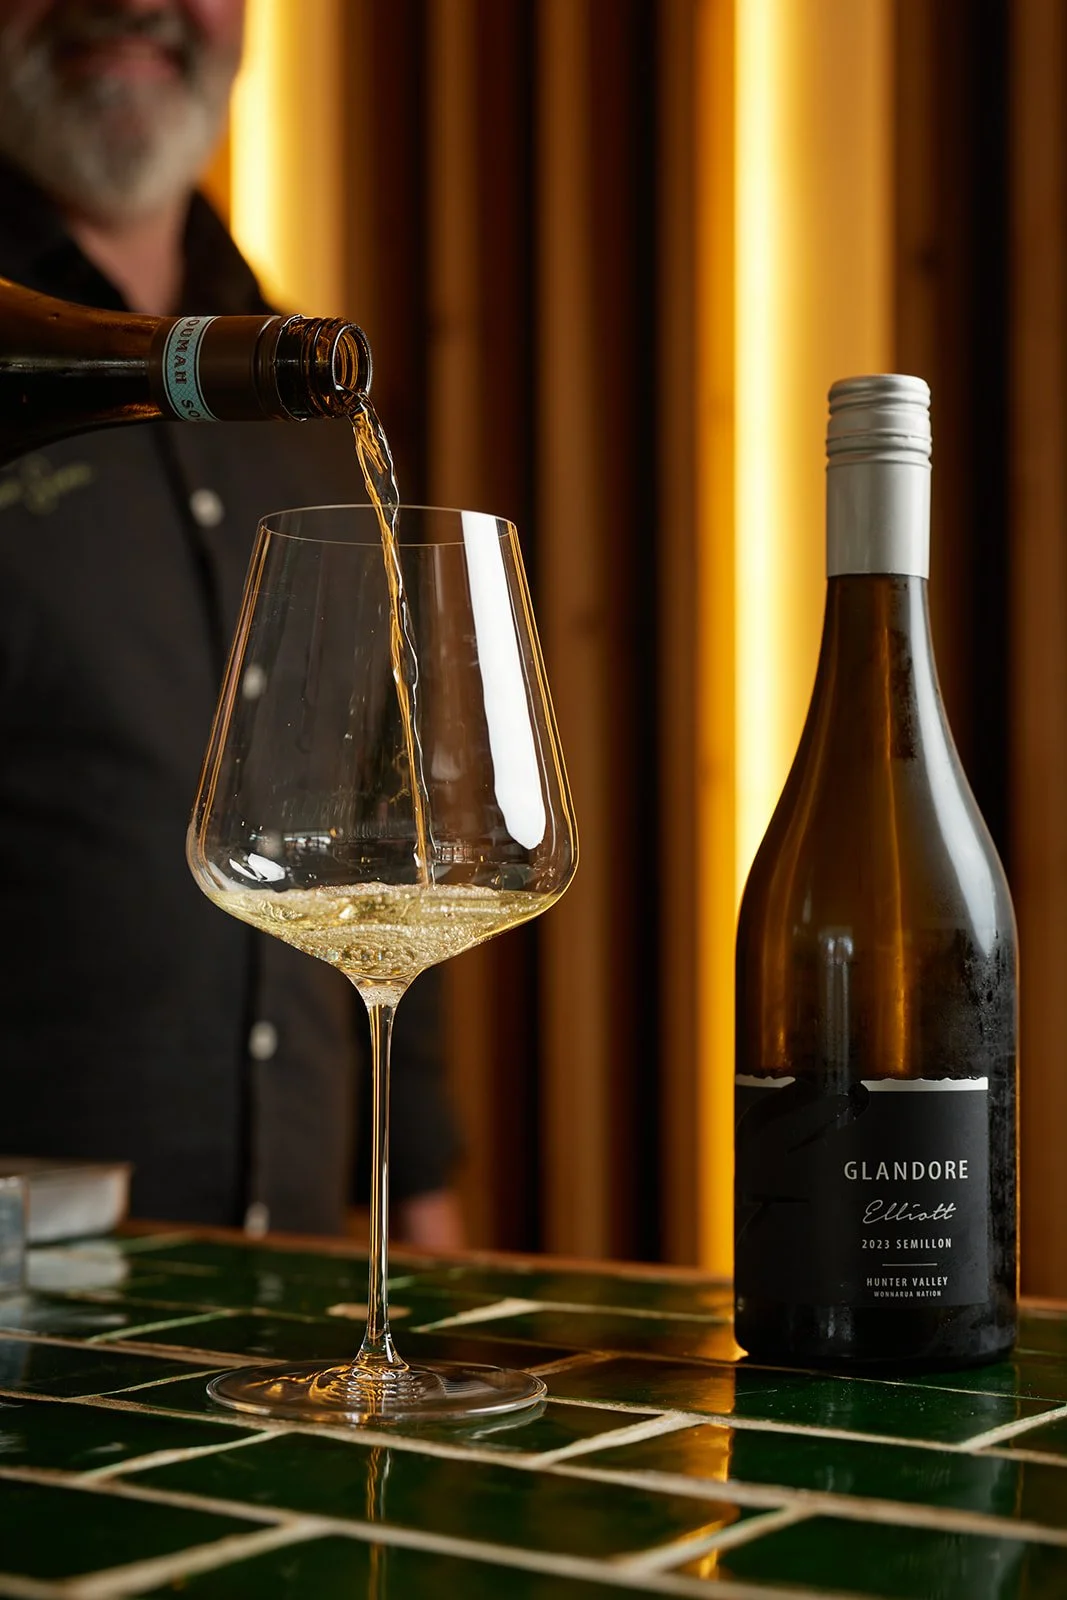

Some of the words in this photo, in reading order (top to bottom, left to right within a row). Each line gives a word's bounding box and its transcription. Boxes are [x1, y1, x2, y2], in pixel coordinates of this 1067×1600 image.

[174, 317, 201, 385] OUMAH
[843, 1159, 969, 1181] GLANDORE
[862, 1199, 957, 1225] Elliott
[861, 1239, 890, 1250] 2023
[895, 1237, 952, 1250] SEMILLON
[866, 1277, 908, 1287] HUNTER
[911, 1276, 949, 1287] VALLEY
